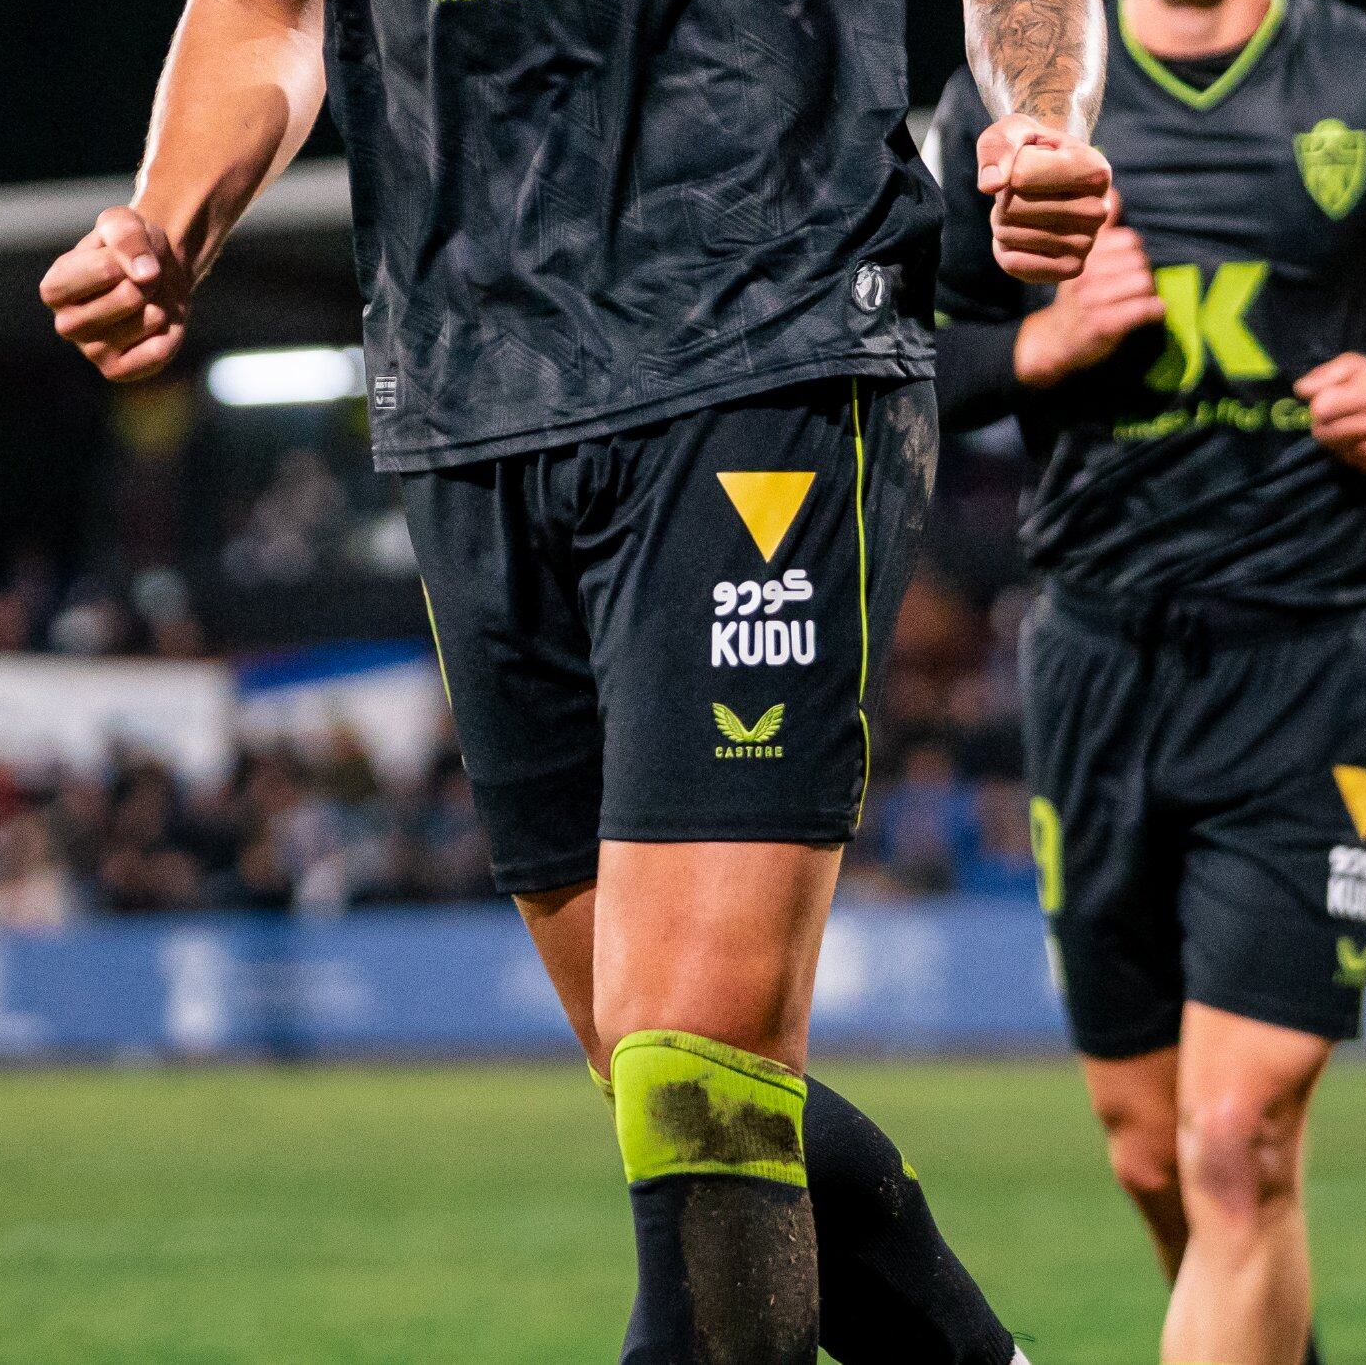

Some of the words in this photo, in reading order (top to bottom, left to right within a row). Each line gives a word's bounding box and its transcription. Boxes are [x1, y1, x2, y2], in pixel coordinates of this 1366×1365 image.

[713, 569, 813, 616] كودو
[711, 619, 816, 668] KUDU
[715, 746, 784, 758] CASTORE
